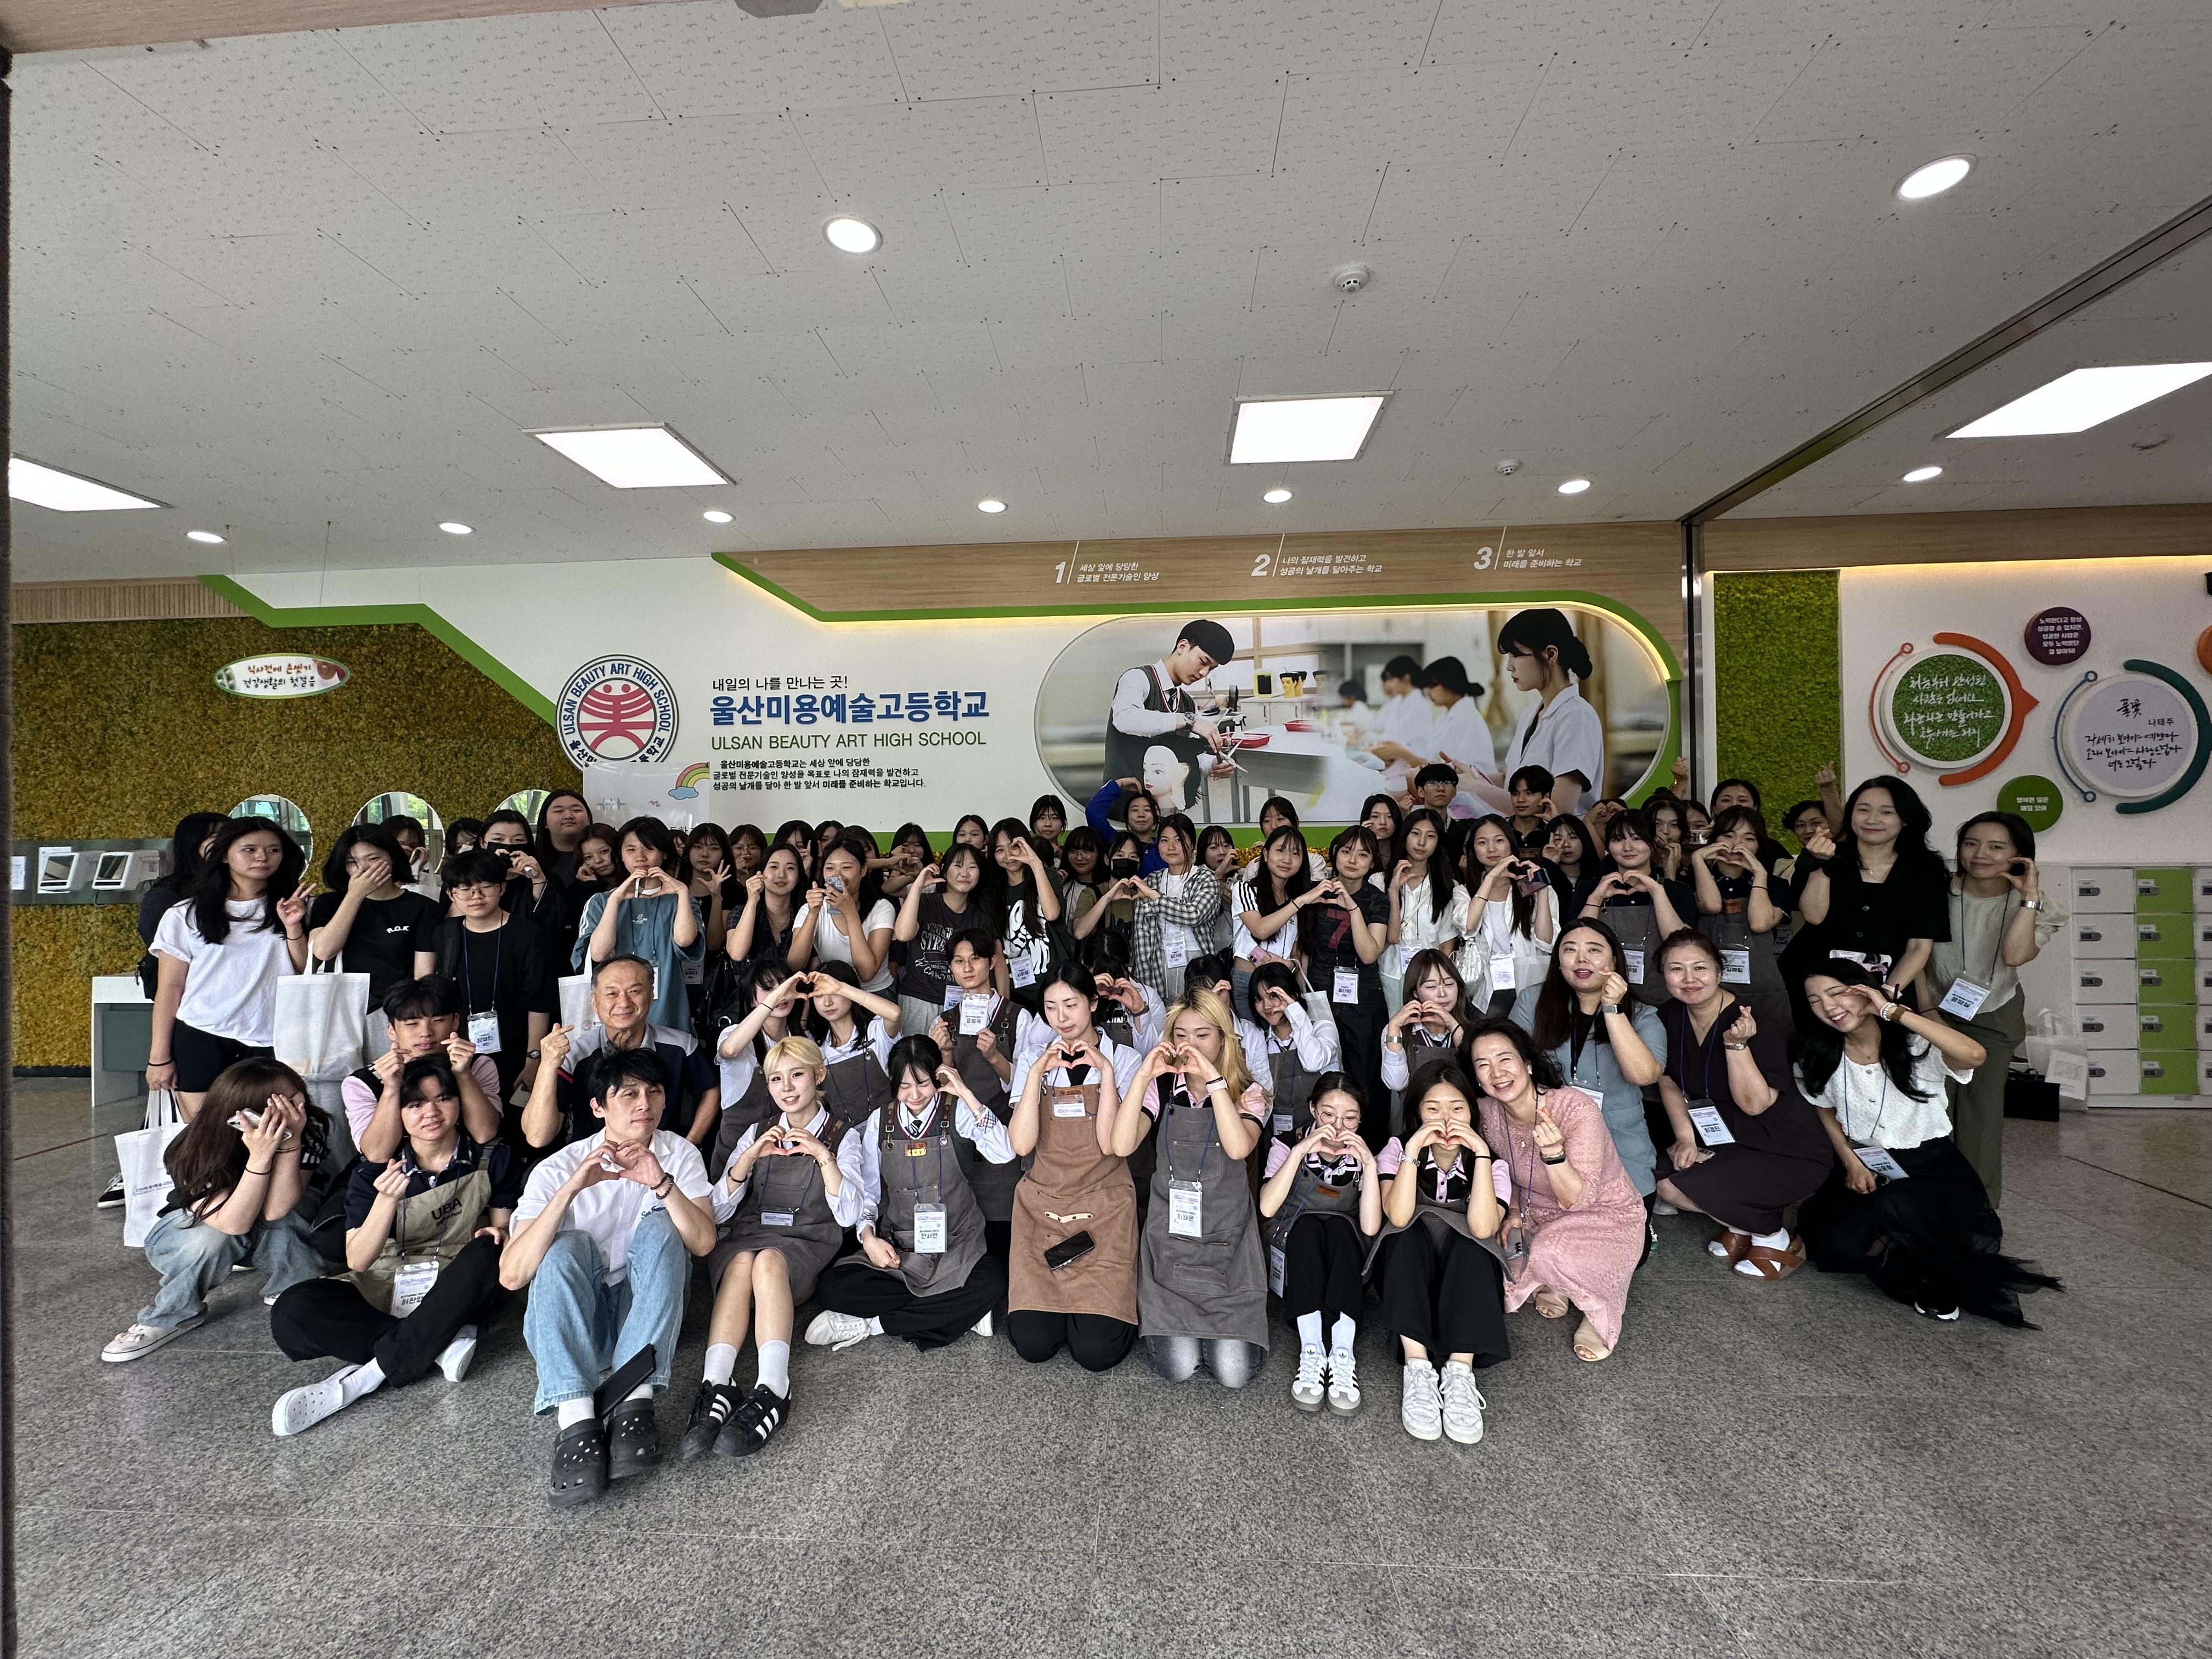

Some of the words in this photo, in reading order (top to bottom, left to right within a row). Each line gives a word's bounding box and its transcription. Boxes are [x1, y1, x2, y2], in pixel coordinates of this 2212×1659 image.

[1283, 556, 1299, 565] 나의
[1301, 555, 1333, 564] 잠재력을
[1335, 554, 1367, 563] 발견하고
[1474, 546, 1493, 570] 3
[1506, 549, 1515, 558] 한
[1517, 549, 1526, 557] 발
[1528, 548, 1545, 557] 앞서
[1079, 563, 1096, 572] 세상
[1098, 563, 1113, 572] 앞에
[1115, 562, 1139, 571] 당당한
[1251, 554, 1271, 576] 2
[1280, 567, 1304, 576] 성공의
[1306, 566, 1330, 575] 날개를
[1333, 565, 1364, 574] 달아주는
[1367, 565, 1383, 573] 학교
[1503, 560, 1528, 569] 미래를
[1530, 559, 1563, 568] 준비하는
[1565, 558, 1582, 567] 학교
[1055, 561, 1066, 583] 1
[1077, 574, 1101, 583] 글로벌
[1103, 573, 1141, 582] 전문기술인
[1143, 572, 1159, 580] 양성
[248, 664, 281, 674] 식사전에
[286, 663, 312, 674] 손씻기
[243, 676, 286, 690] 건강생활의
[290, 675, 315, 687] 첫걸음
[712, 678, 751, 691] 내일의
[755, 677, 782, 690] 나를
[786, 676, 825, 690] 만나는
[830, 675, 848, 689] 곳!
[1910, 673, 1948, 689] 처음부터
[1952, 674, 1987, 686] 완성된
[563, 698, 578, 735] ULSAN
[571, 665, 606, 698] BEAUTY
[610, 663, 632, 675] ART
[633, 667, 658, 691] HIGH
[653, 689, 672, 732] SCHOOL
[710, 691, 990, 726] 울산미용예술고등학교
[2117, 698, 2142, 718] 풀꽃
[712, 736, 763, 750] ULSAN
[769, 734, 831, 749] BEAUTY
[836, 733, 868, 748] ART
[874, 732, 913, 747] HIGH
[918, 731, 987, 746] SCHOOL
[2085, 733, 2114, 747] 자세히
[2118, 733, 2143, 744] 보아야
[2145, 731, 2179, 742] 예쁘다
[2087, 748, 2102, 760] 오래
[2106, 747, 2134, 758] 보아야
[2136, 743, 2182, 756] 사랑스럽다
[720, 759, 807, 769] 울산미용예술고등학교는
[809, 759, 825, 768] 세상
[828, 758, 843, 767] 앞에
[845, 758, 870, 767] 당당한
[2108, 760, 2123, 771] 너도
[2126, 757, 2157, 770] 그렇다
[713, 770, 736, 780] 글로벌
[738, 770, 778, 780] 전문기술인
[781, 769, 805, 779] 양성을
[807, 769, 831, 778] 목표로
[833, 769, 849, 778] 나의
[851, 768, 884, 777] 잠재력을
[886, 768, 918, 777] 발견하고
[713, 781, 737, 791] 성공의
[739, 780, 763, 790] 날개를
[765, 780, 781, 789] 달아
[783, 780, 791, 789] 한
[794, 780, 802, 789] 발
[804, 780, 820, 789] 앞서
[822, 779, 847, 789] 미래를
[849, 779, 881, 788] 준비하는
[883, 778, 927, 788] 학교입니다.
[1325, 908, 1351, 949] 7
[921, 930, 946, 953] STRE
[431, 1198, 462, 1220] UBA
